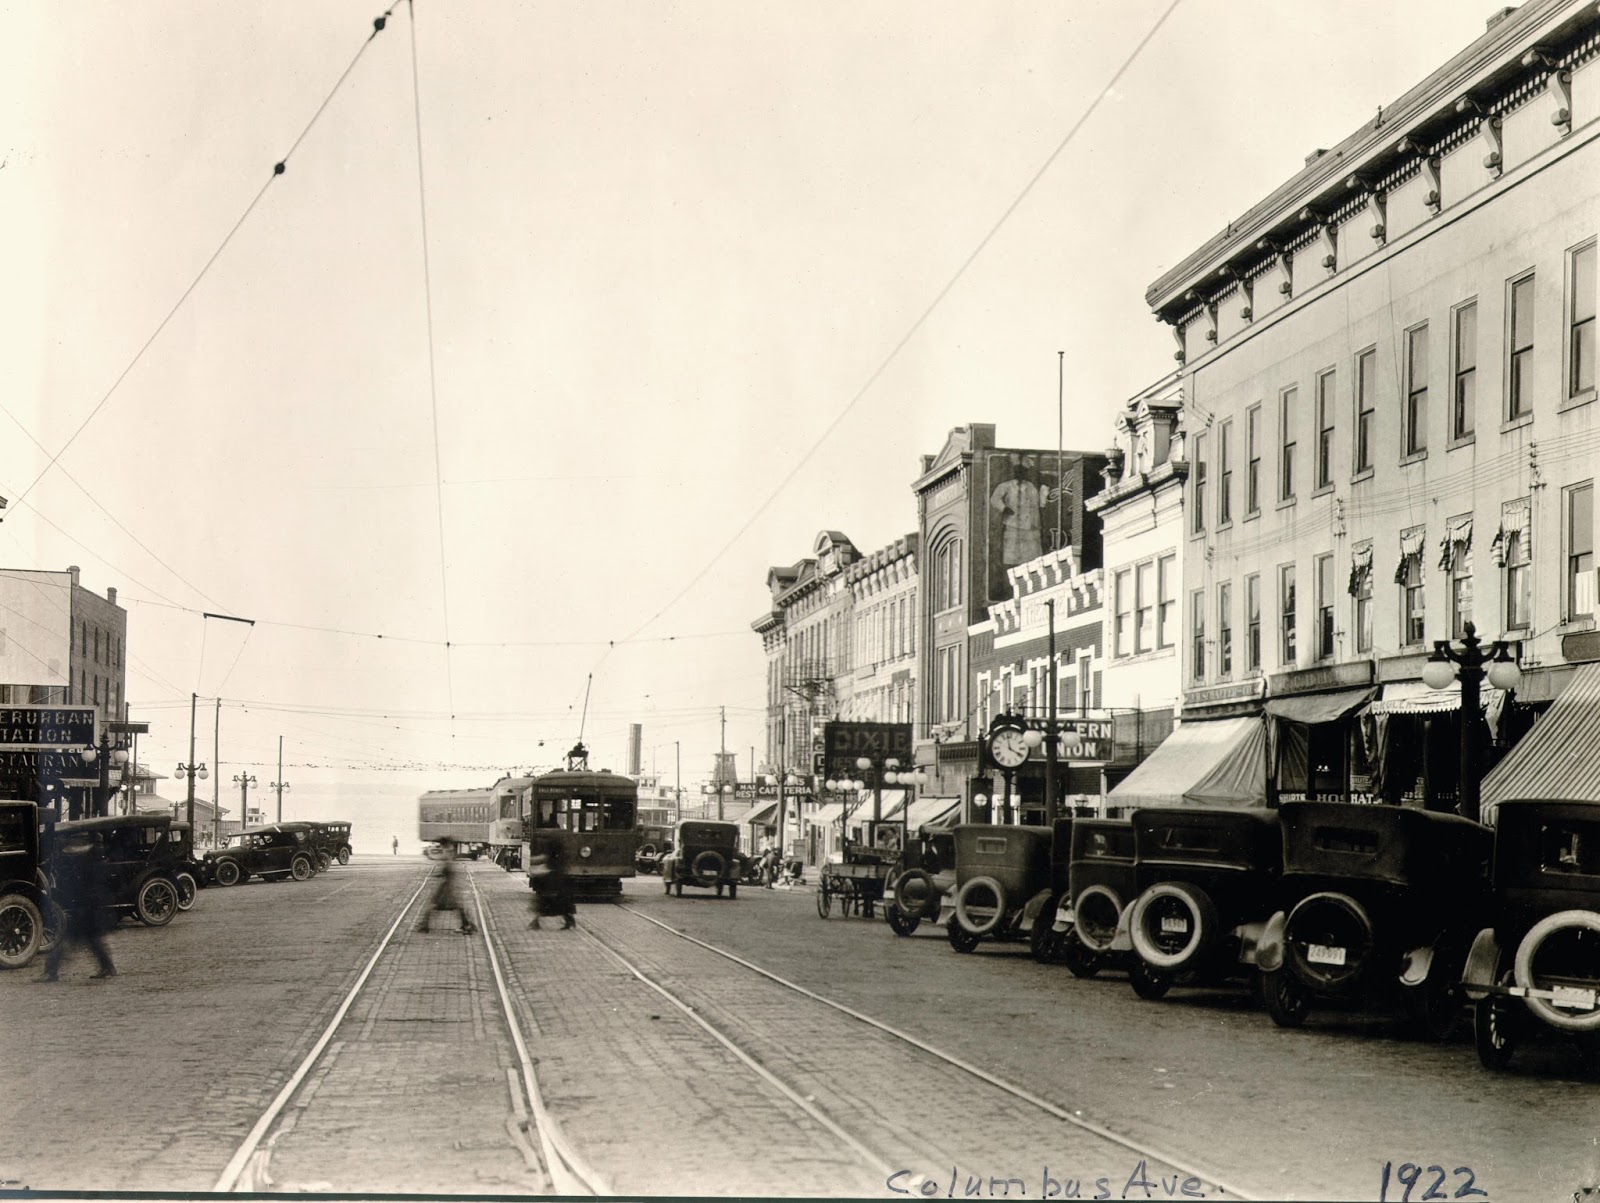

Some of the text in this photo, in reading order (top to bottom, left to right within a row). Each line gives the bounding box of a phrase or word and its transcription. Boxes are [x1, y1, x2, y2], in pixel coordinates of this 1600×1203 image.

[0, 711, 93, 726] ERURBAN
[0, 728, 71, 742] TATION
[834, 731, 908, 751] DIXIE
[0, 767, 63, 776] IGARS
[758, 786, 812, 796] CAFTERIA
